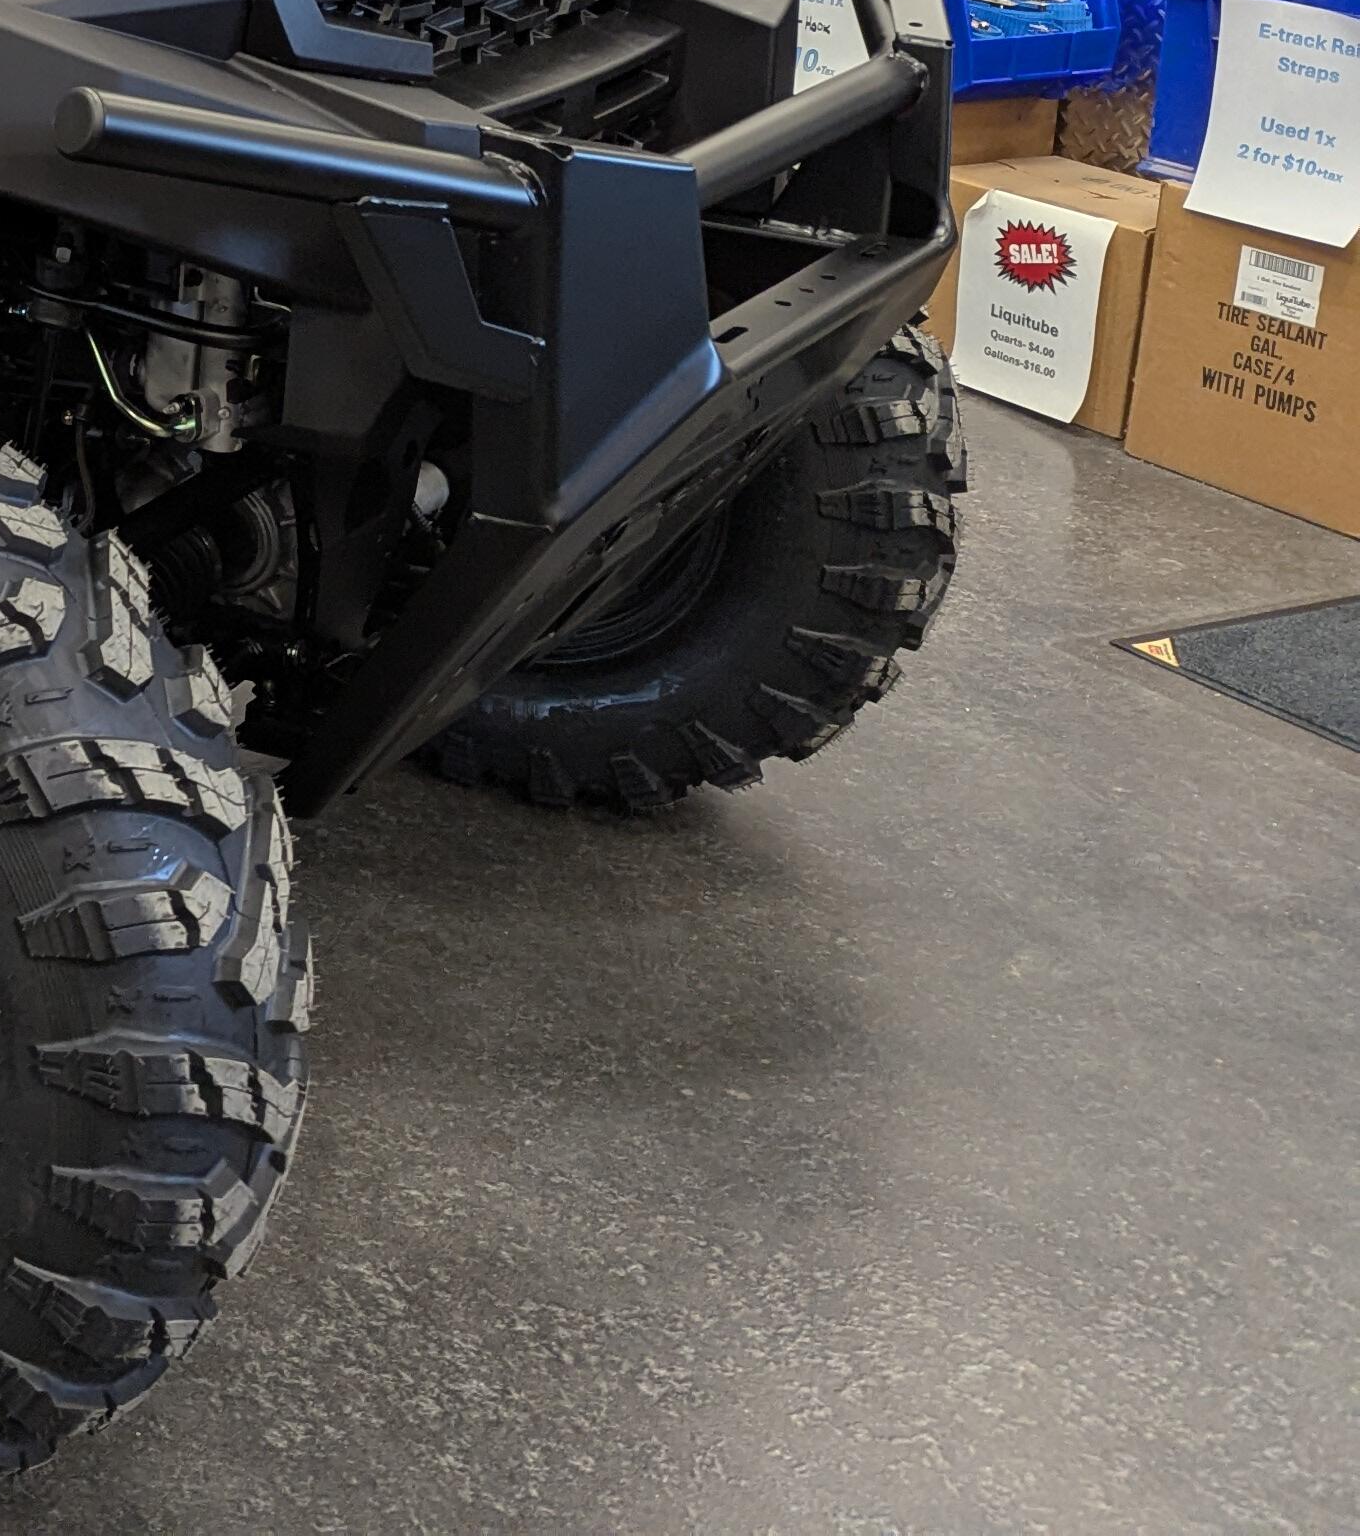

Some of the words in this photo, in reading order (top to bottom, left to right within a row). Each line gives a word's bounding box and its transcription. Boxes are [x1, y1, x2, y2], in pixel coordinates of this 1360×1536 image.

[1258, 23, 1327, 52] E-track
[1277, 56, 1340, 84] Straps
[1260, 116, 1310, 141] Used
[1314, 130, 1337, 148] 1x
[1236, 143, 1250, 159] 2
[1253, 147, 1280, 166] for
[1008, 243, 1059, 264] SALE!
[990, 303, 1059, 338] Liquitube
[1217, 301, 1250, 327] TIRE
[1256, 314, 1328, 351] SEALANT
[990, 329, 1027, 349] Quarts-
[1027, 341, 1055, 359] $4.00
[1250, 335, 1283, 360] GAL.
[1233, 351, 1296, 386] CASE/4
[1202, 366, 1246, 400] WITH
[1253, 384, 1317, 423] PUMPS
